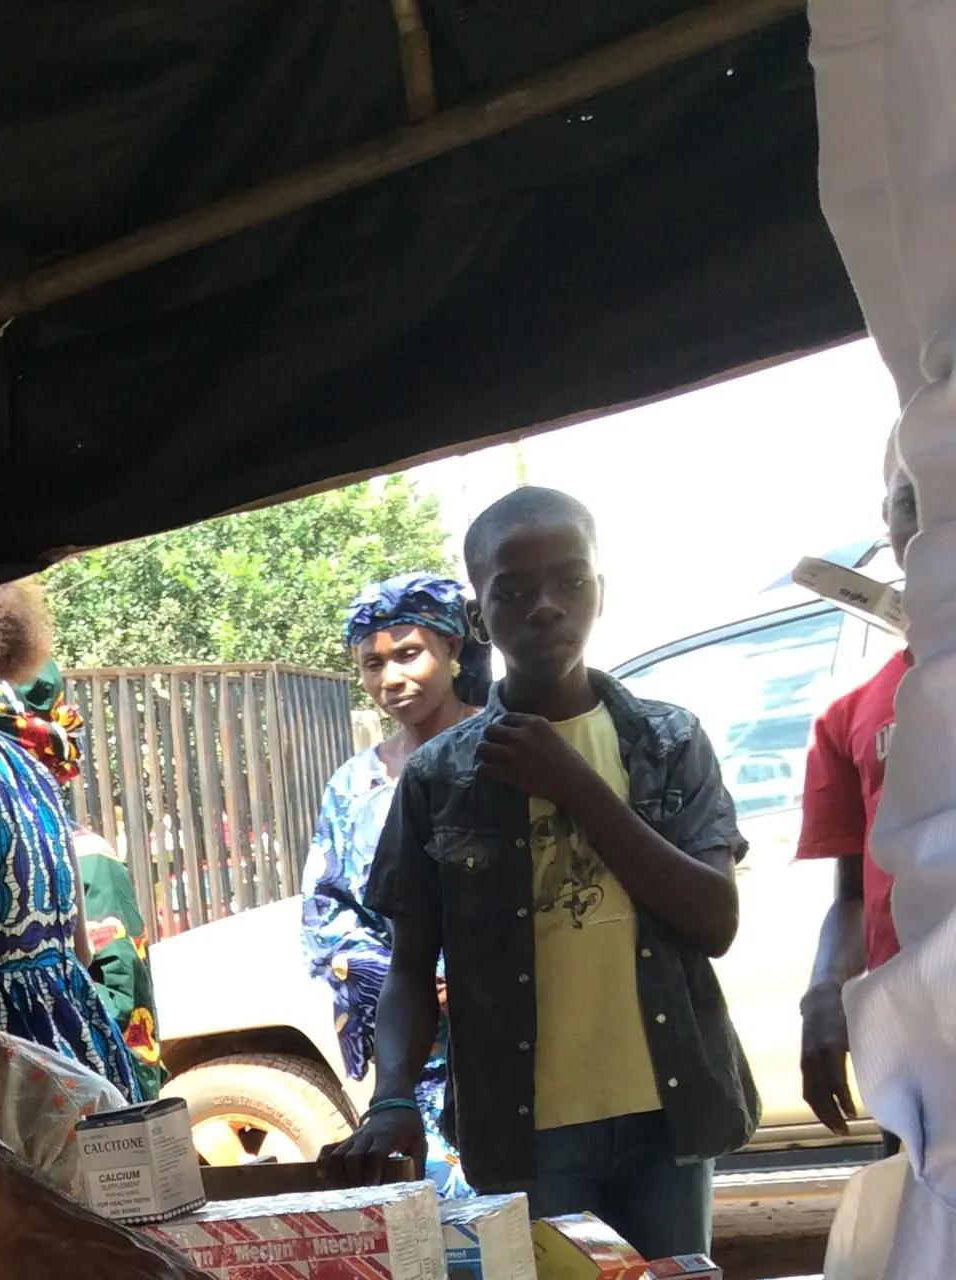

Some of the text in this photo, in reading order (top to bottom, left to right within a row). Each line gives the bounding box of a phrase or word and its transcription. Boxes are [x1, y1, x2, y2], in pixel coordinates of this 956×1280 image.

[84, 1137, 144, 1155] CALCITONE
[99, 1170, 140, 1183] CALCIUM
[235, 1242, 294, 1263] Meclyn
[313, 1235, 376, 1256] Meclyn
